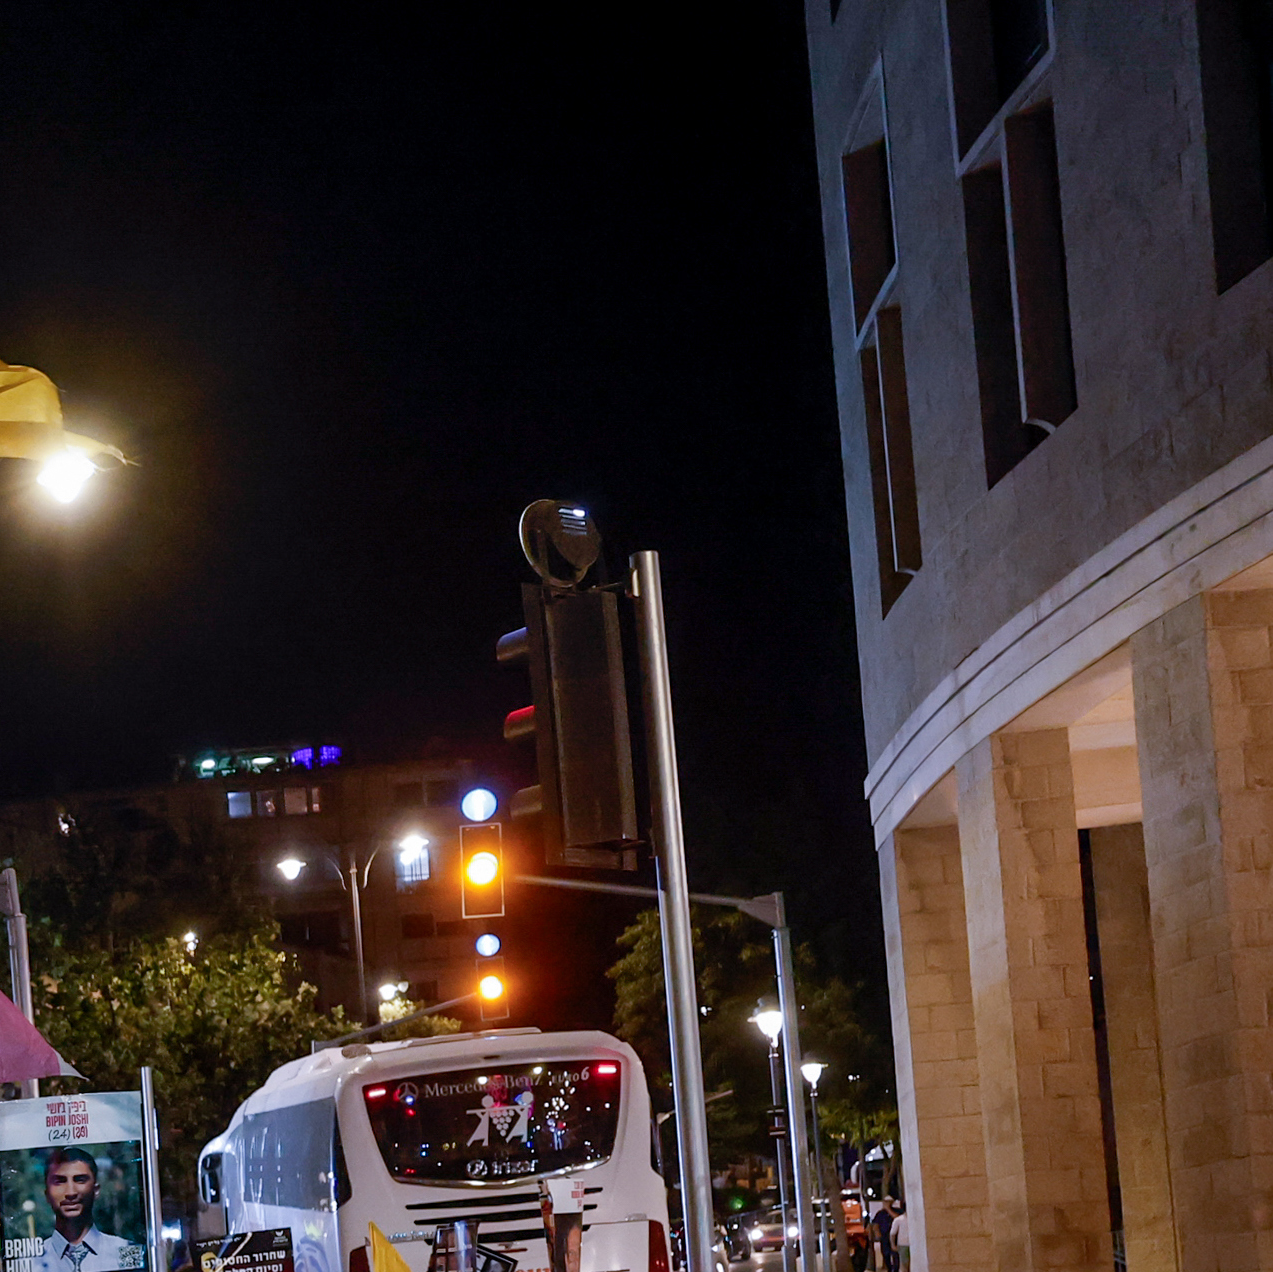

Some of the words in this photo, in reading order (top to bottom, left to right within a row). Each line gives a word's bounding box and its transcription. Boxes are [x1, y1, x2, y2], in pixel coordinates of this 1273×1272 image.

[46, 1115, 66, 1127] BIPIN
[68, 1113, 88, 1126] JOSHI
[48, 1129, 71, 1142] (24)
[5, 1237, 44, 1258] BRING
